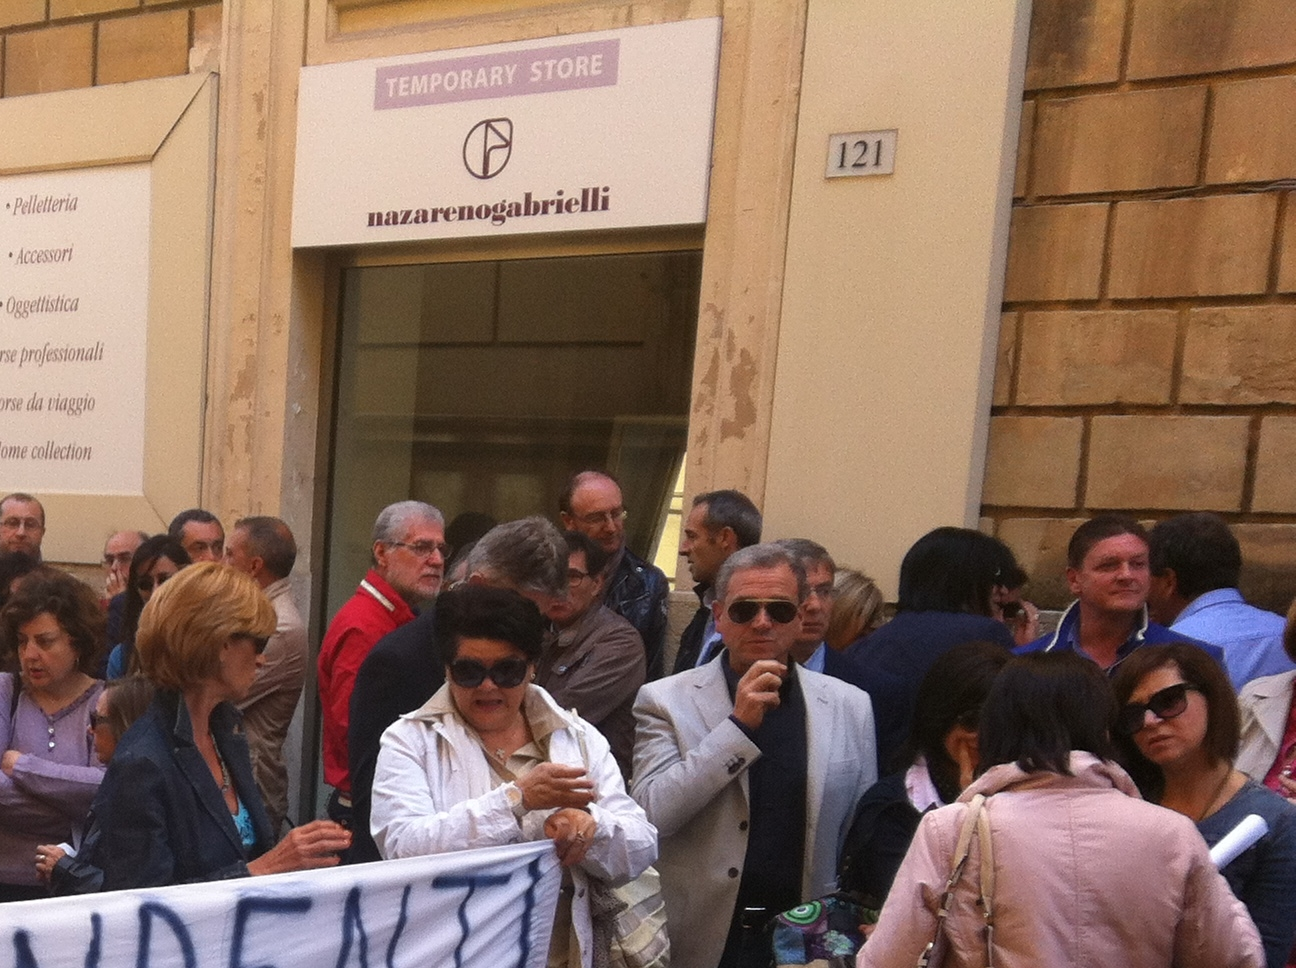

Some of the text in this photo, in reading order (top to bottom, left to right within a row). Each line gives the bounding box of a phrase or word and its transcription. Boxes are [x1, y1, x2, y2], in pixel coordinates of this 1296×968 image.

[386, 53, 604, 98] TEMPORARY STORE
[838, 139, 882, 169] 121
[12, 193, 79, 216] Pelletteria
[367, 186, 610, 227] nazarenogabrielli
[15, 243, 74, 265] Accessori
[6, 294, 80, 319] Oggettistica
[19, 341, 105, 368] professionali
[26, 392, 44, 412] da
[47, 393, 96, 417] viaggio
[31, 440, 92, 461] collection
